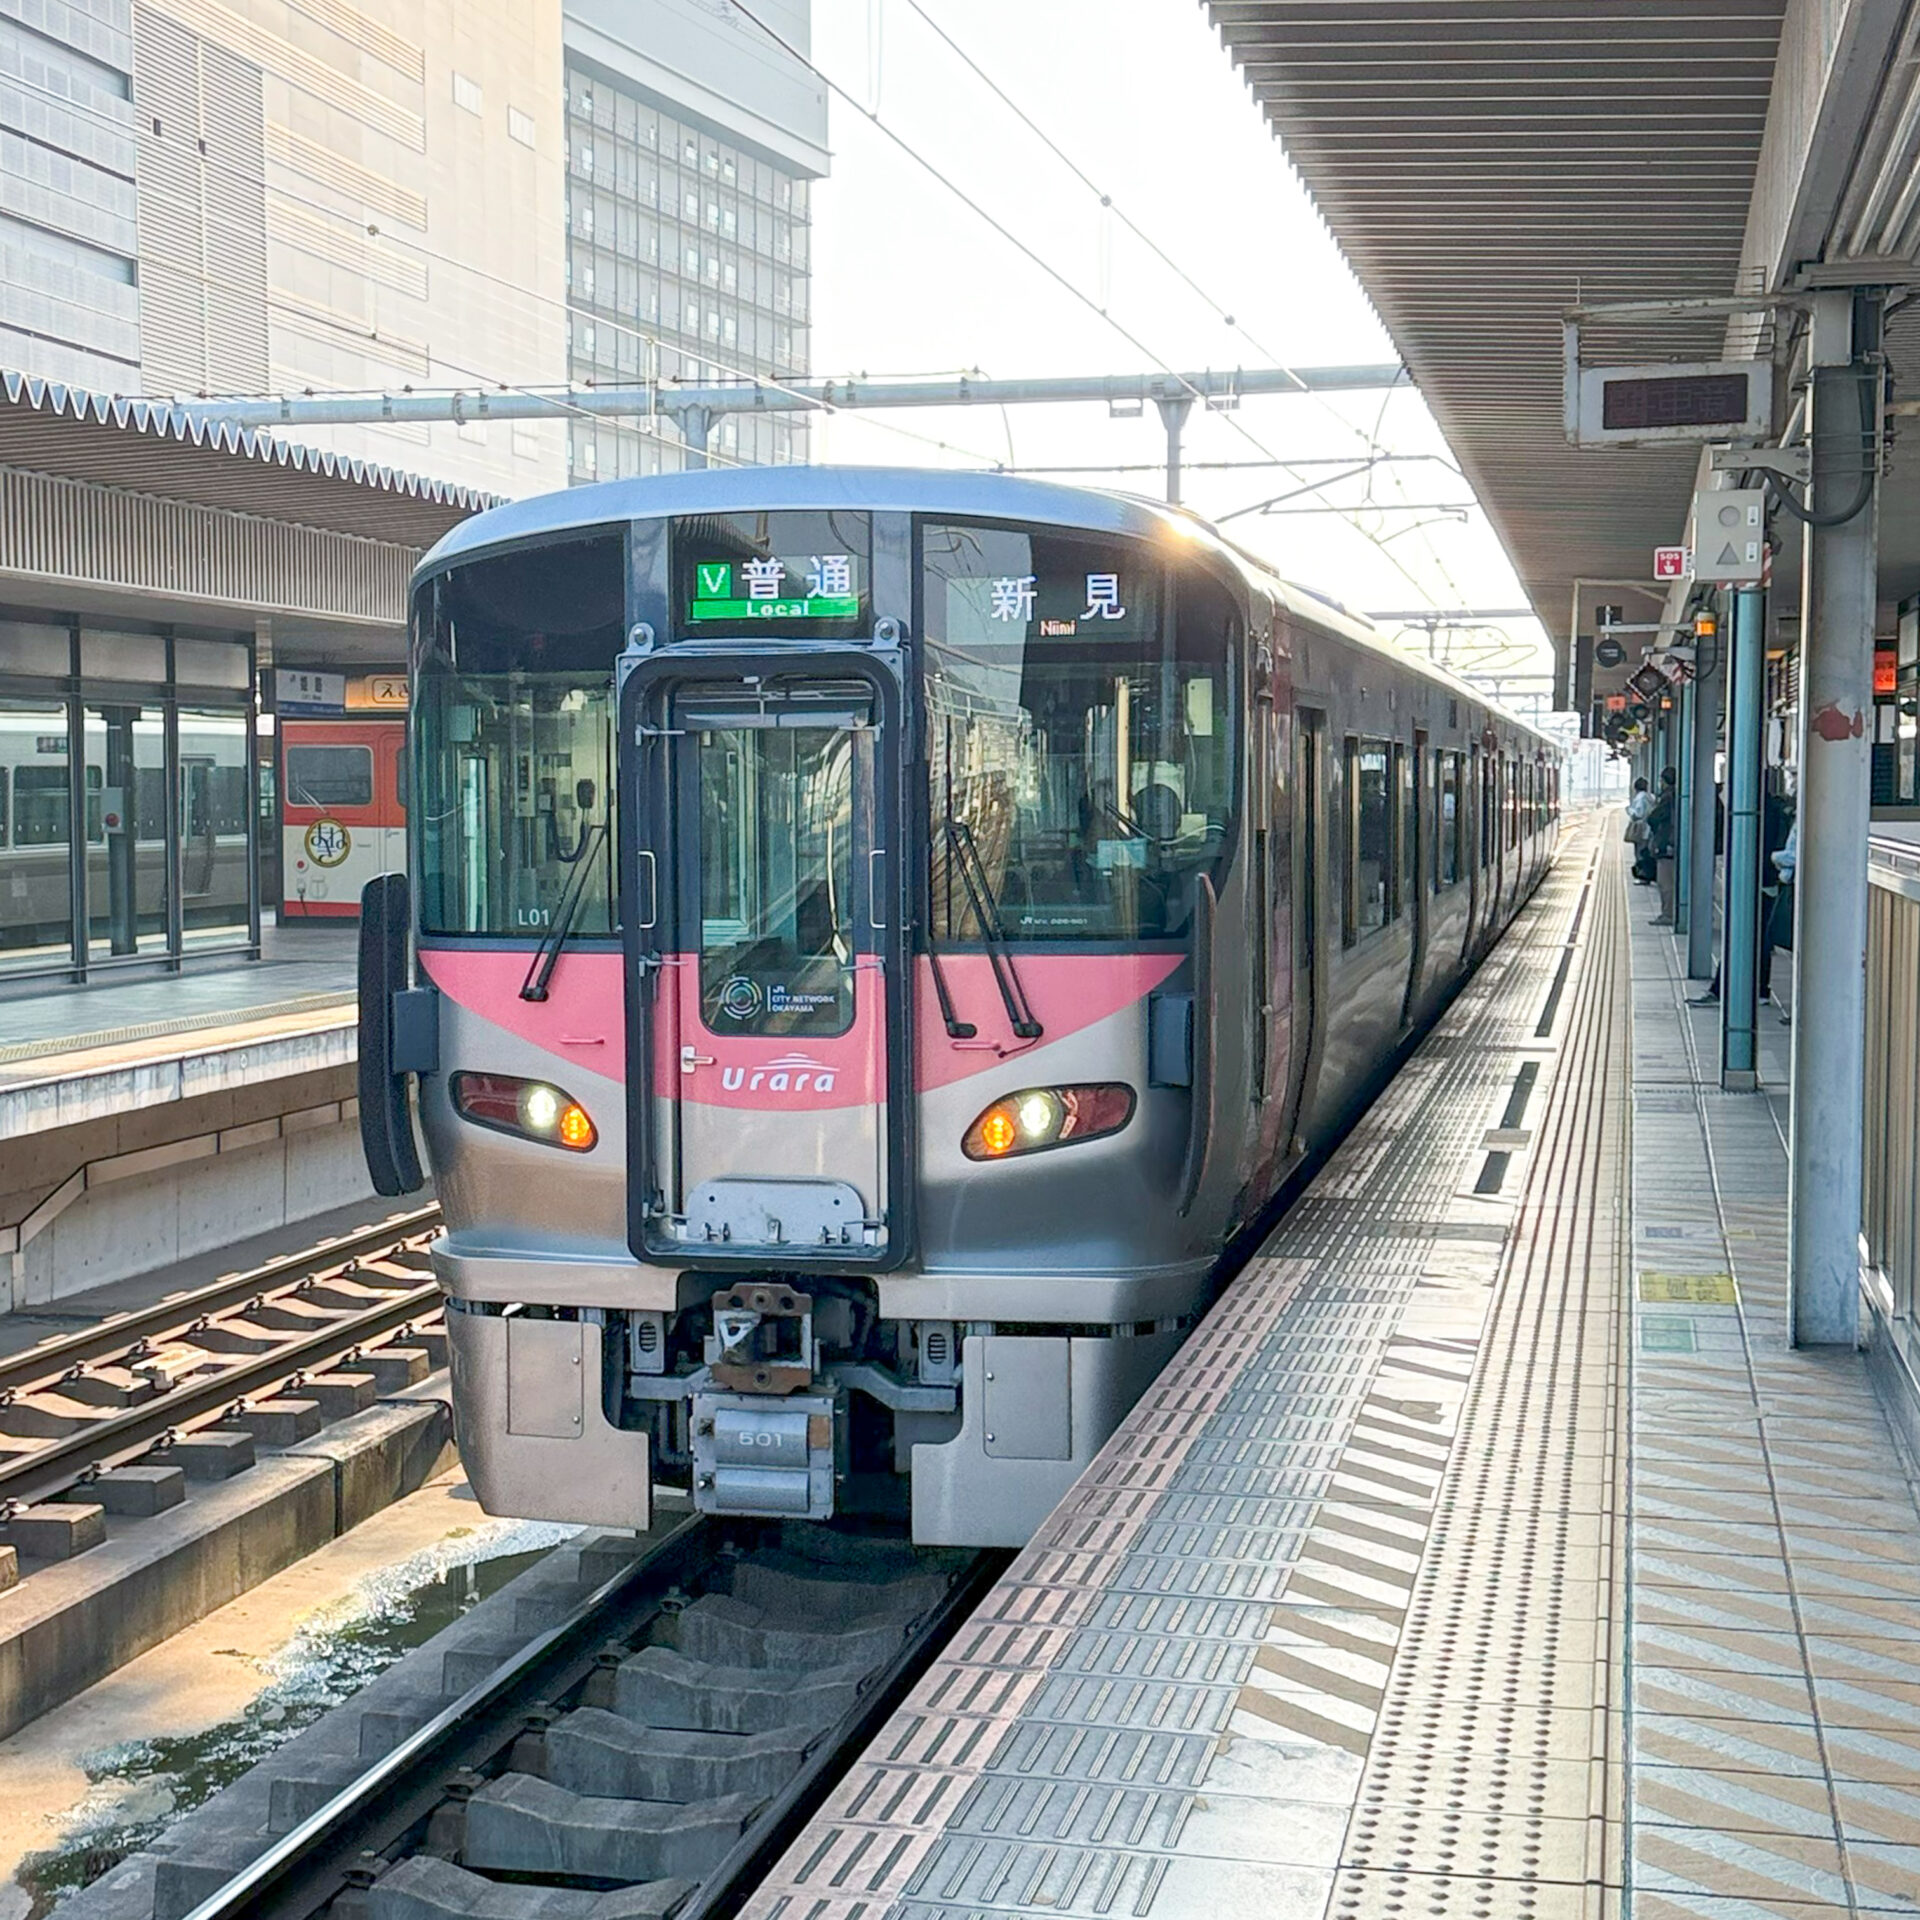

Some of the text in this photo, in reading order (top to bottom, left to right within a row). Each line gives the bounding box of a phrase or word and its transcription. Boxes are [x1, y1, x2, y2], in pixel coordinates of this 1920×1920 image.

[1659, 552, 1680, 561] SOS
[702, 566, 728, 593] V
[741, 555, 852, 600] 普通
[991, 573, 1127, 623] 新見
[746, 601, 810, 617] Local
[1040, 619, 1076, 636] Niimi
[518, 908, 550, 926] L01
[772, 985, 785, 993] JR
[772, 995, 836, 1003] CITY NETWORK
[772, 1004, 815, 1012] OKAYAMA
[722, 1067, 836, 1092] Urara
